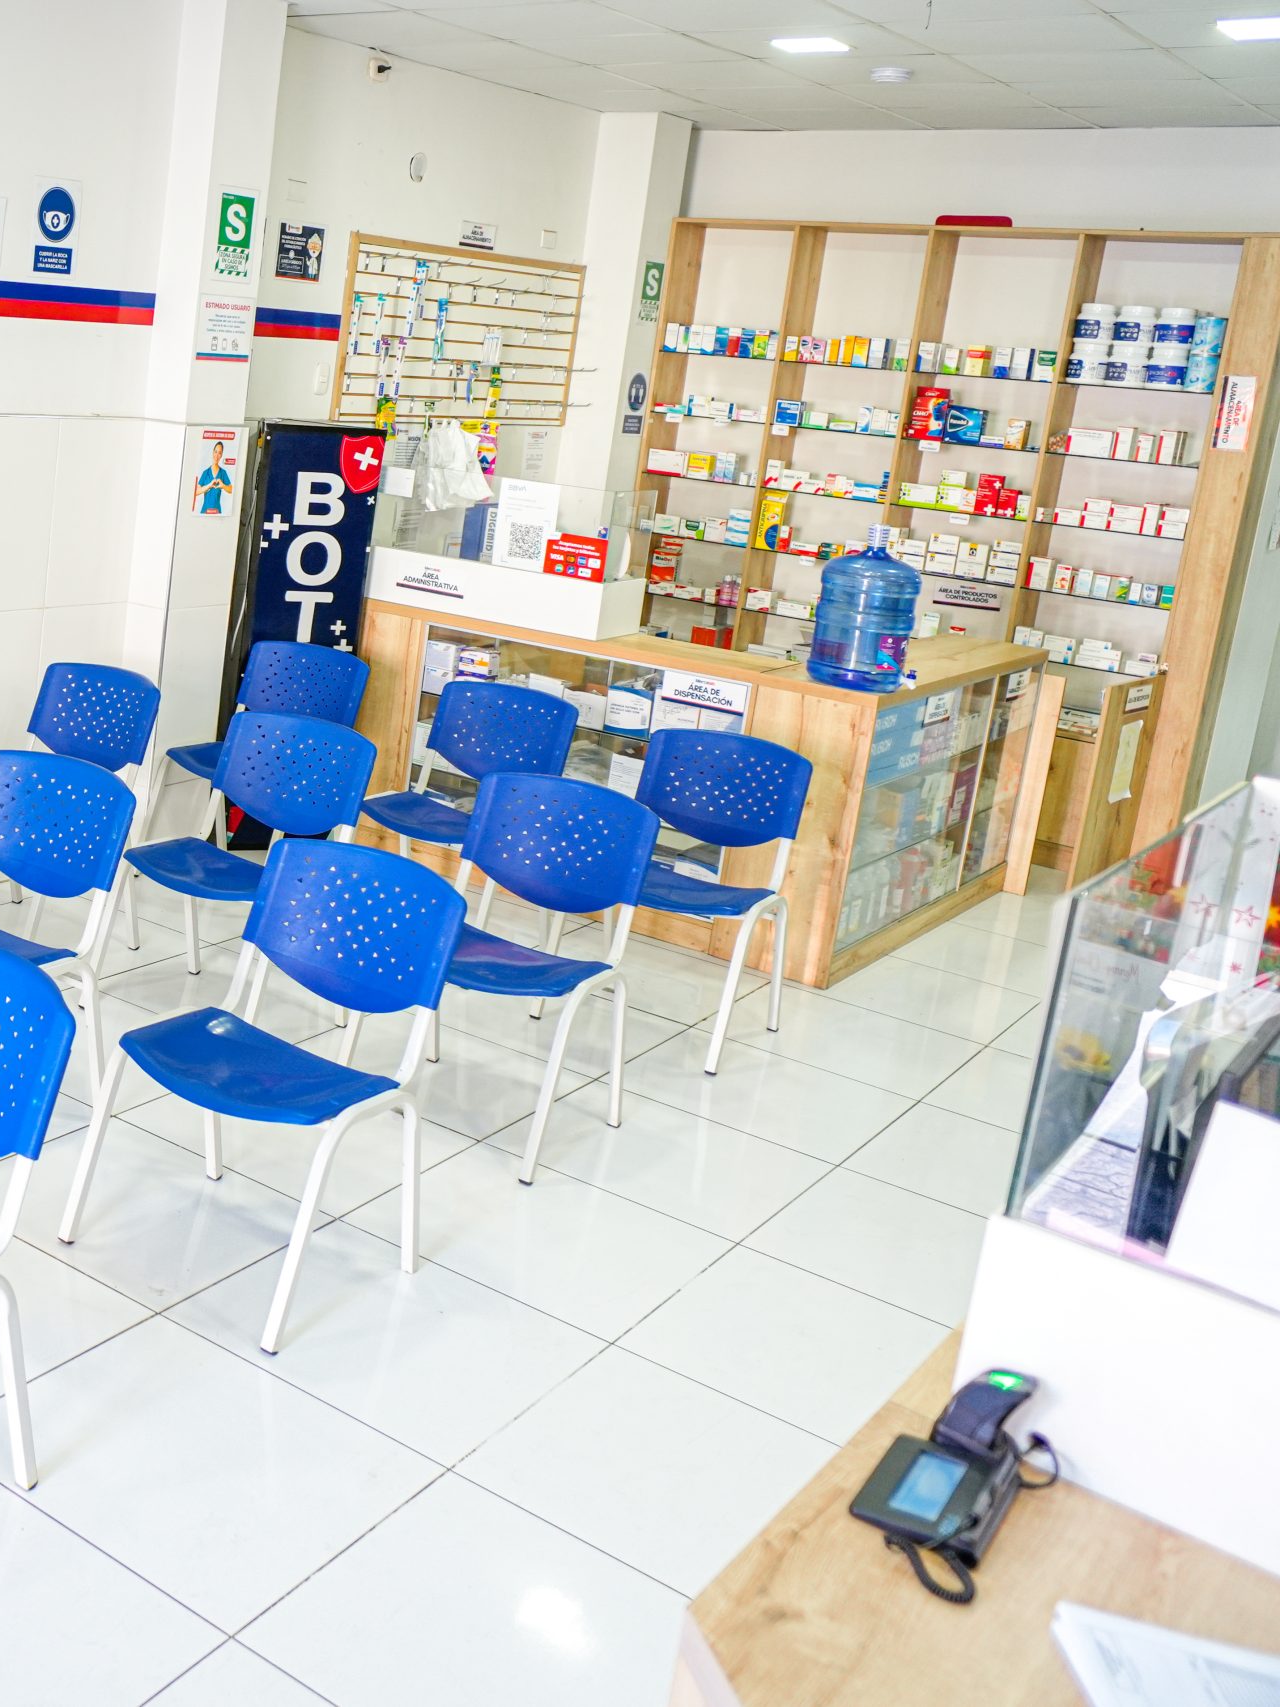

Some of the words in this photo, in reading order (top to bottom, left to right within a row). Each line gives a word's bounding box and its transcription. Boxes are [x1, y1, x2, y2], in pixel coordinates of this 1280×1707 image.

[225, 204, 247, 242] S
[646, 269, 660, 297] S
[1222, 382, 1238, 444] ALMACENAMIENTO
[403, 576, 458, 591] ADMINISTRATIVA
[939, 586, 952, 594] ÁREA
[962, 590, 997, 599] PRODUCTOS
[946, 594, 989, 604] CONTROLADOS
[674, 689, 732, 706] DISPENSACIÓN
[689, 683, 709, 694] ÁREA
[710, 688, 720, 696] DE
